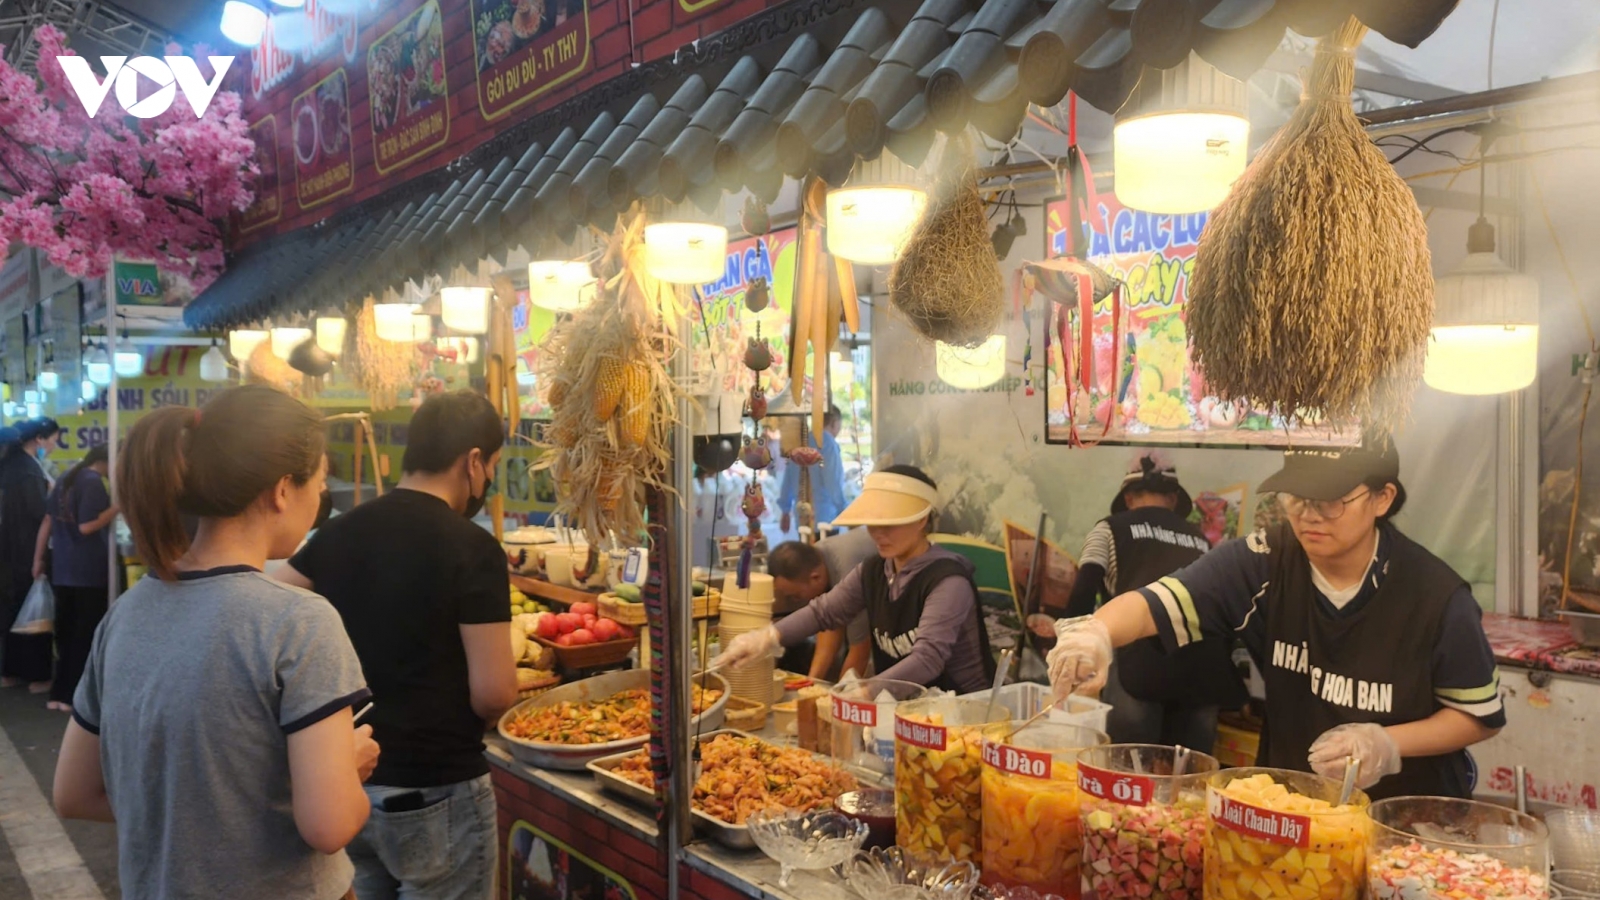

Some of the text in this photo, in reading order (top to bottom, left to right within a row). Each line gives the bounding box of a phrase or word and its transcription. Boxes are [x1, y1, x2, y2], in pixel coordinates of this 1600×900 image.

[487, 69, 505, 103] GỎI
[522, 48, 536, 85] ĐỦ
[543, 43, 555, 71] TY
[557, 30, 577, 63] THY
[1130, 521, 1154, 539] NHÀ
[1153, 525, 1176, 545] HÀNG
[1175, 533, 1195, 549] HOA
[1272, 640, 1309, 675] NHÀ
[1321, 672, 1353, 708] HOA
[1357, 680, 1393, 713] BAN
[841, 701, 872, 724] Dâu
[1005, 748, 1046, 777] Đào
[1078, 770, 1143, 802] Trà Ổi
[1244, 808, 1278, 836] Chanh
[1280, 816, 1303, 844] Dây
